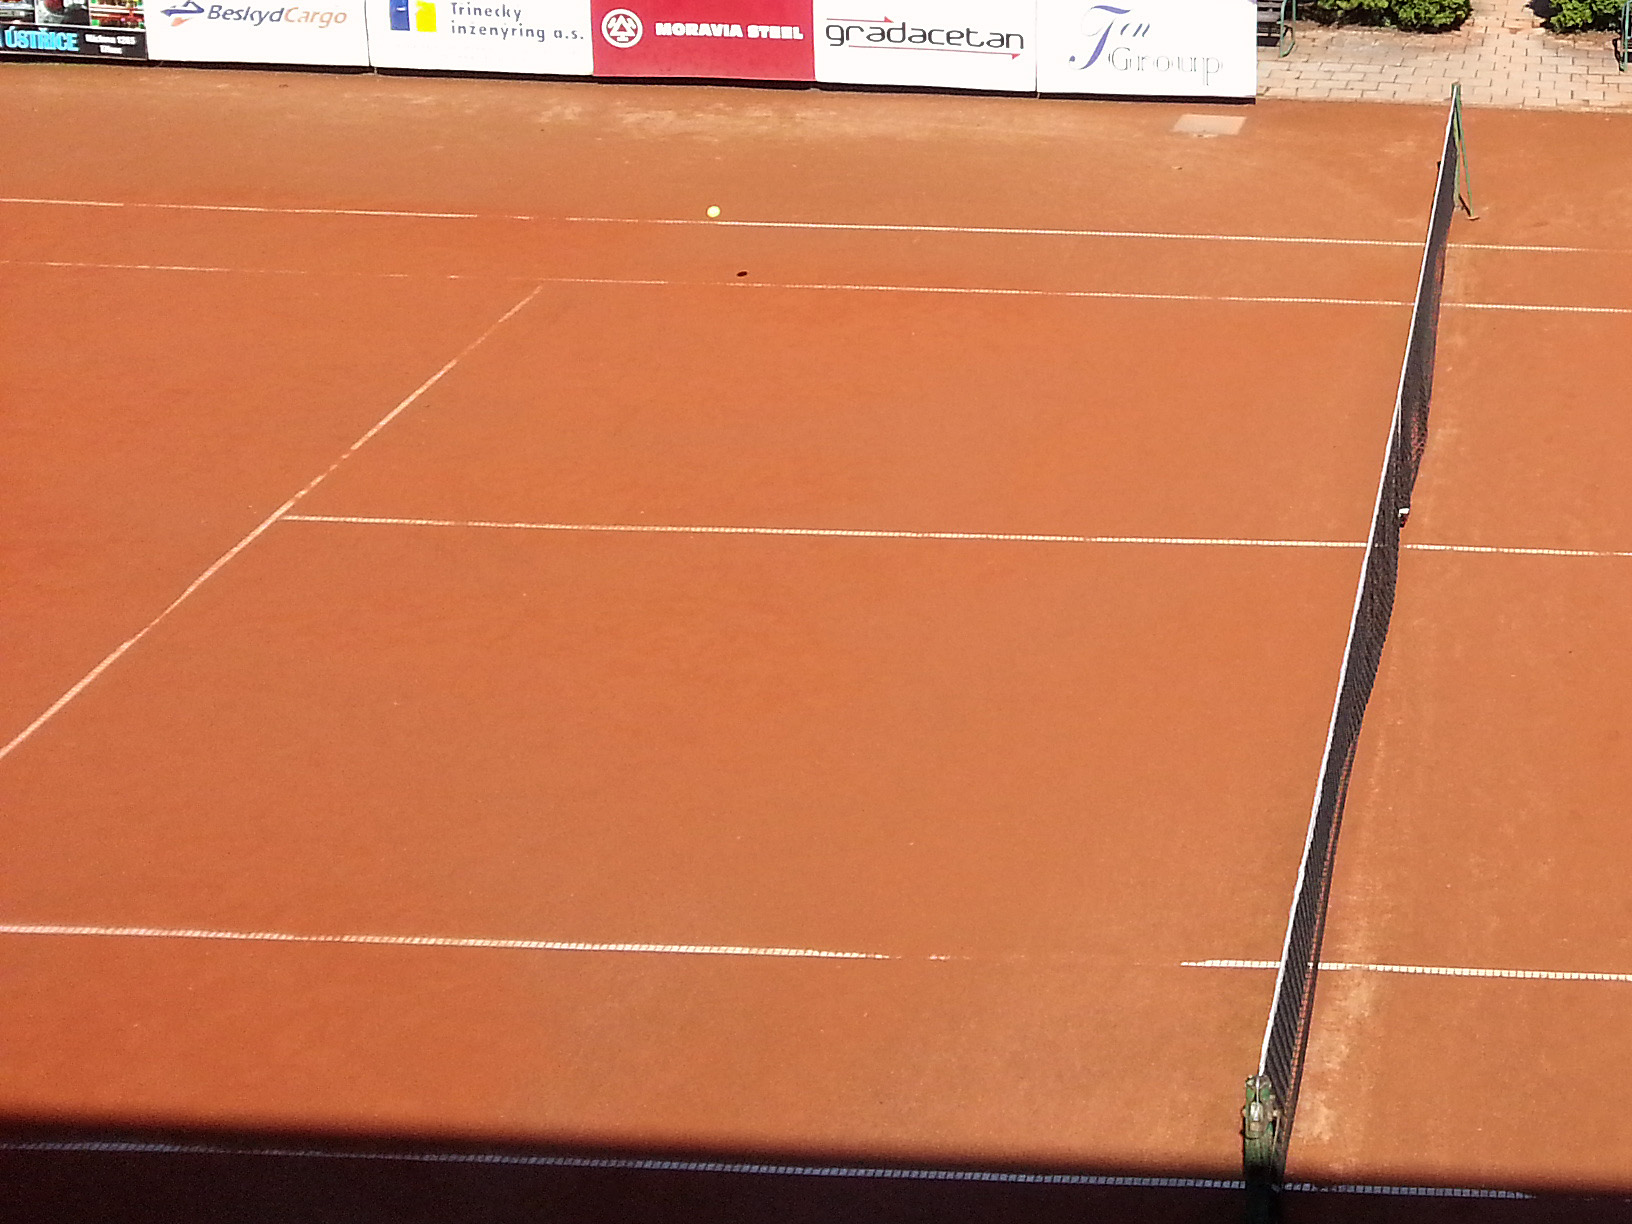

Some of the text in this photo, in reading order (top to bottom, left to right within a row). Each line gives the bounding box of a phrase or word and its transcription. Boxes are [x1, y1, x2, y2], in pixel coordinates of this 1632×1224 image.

[207, 5, 347, 26] BeskydCargo
[553, 30, 584, 40] a.s.
[655, 22, 804, 40] MORAVIA STEEL
[825, 22, 1024, 49] gradacetan
[1108, 46, 1224, 86] Group
